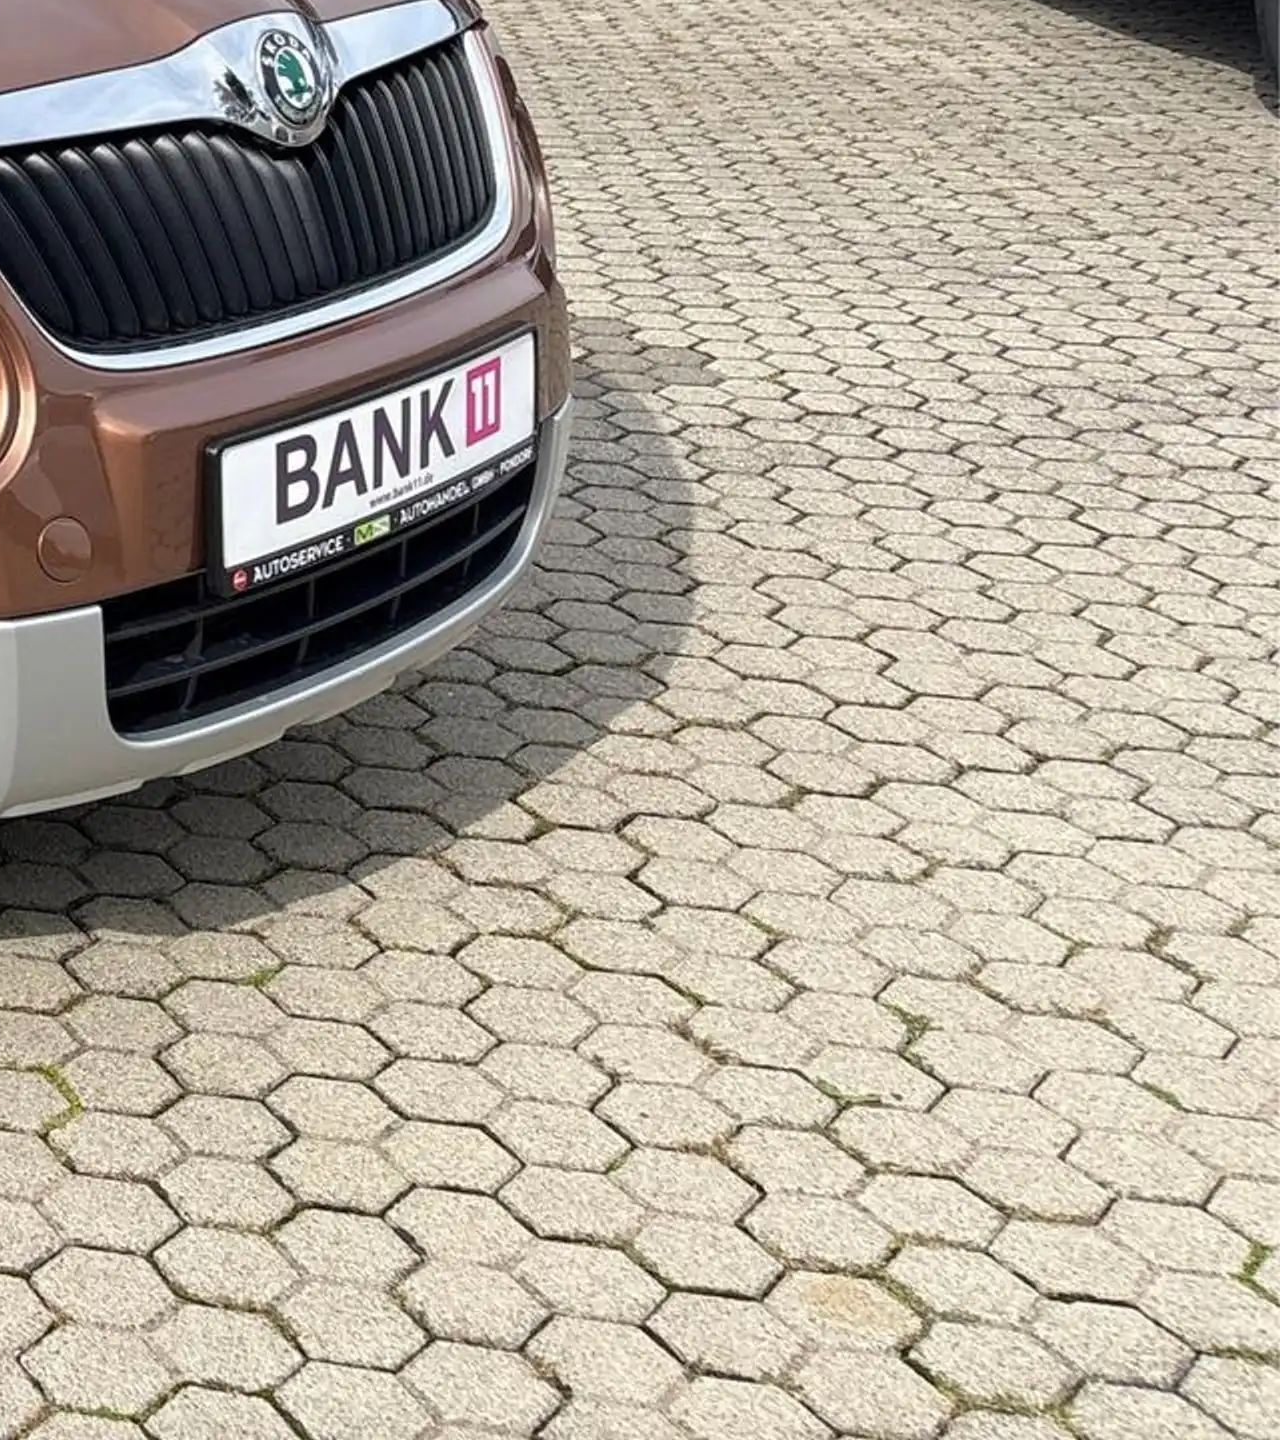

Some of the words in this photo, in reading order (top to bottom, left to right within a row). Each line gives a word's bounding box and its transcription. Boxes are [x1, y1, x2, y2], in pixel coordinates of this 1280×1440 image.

[276, 377, 456, 525] BANK
[470, 364, 498, 437] 11
[253, 534, 344, 584] AUTOSERVICE
[400, 481, 471, 525] AUTOHANDEL
